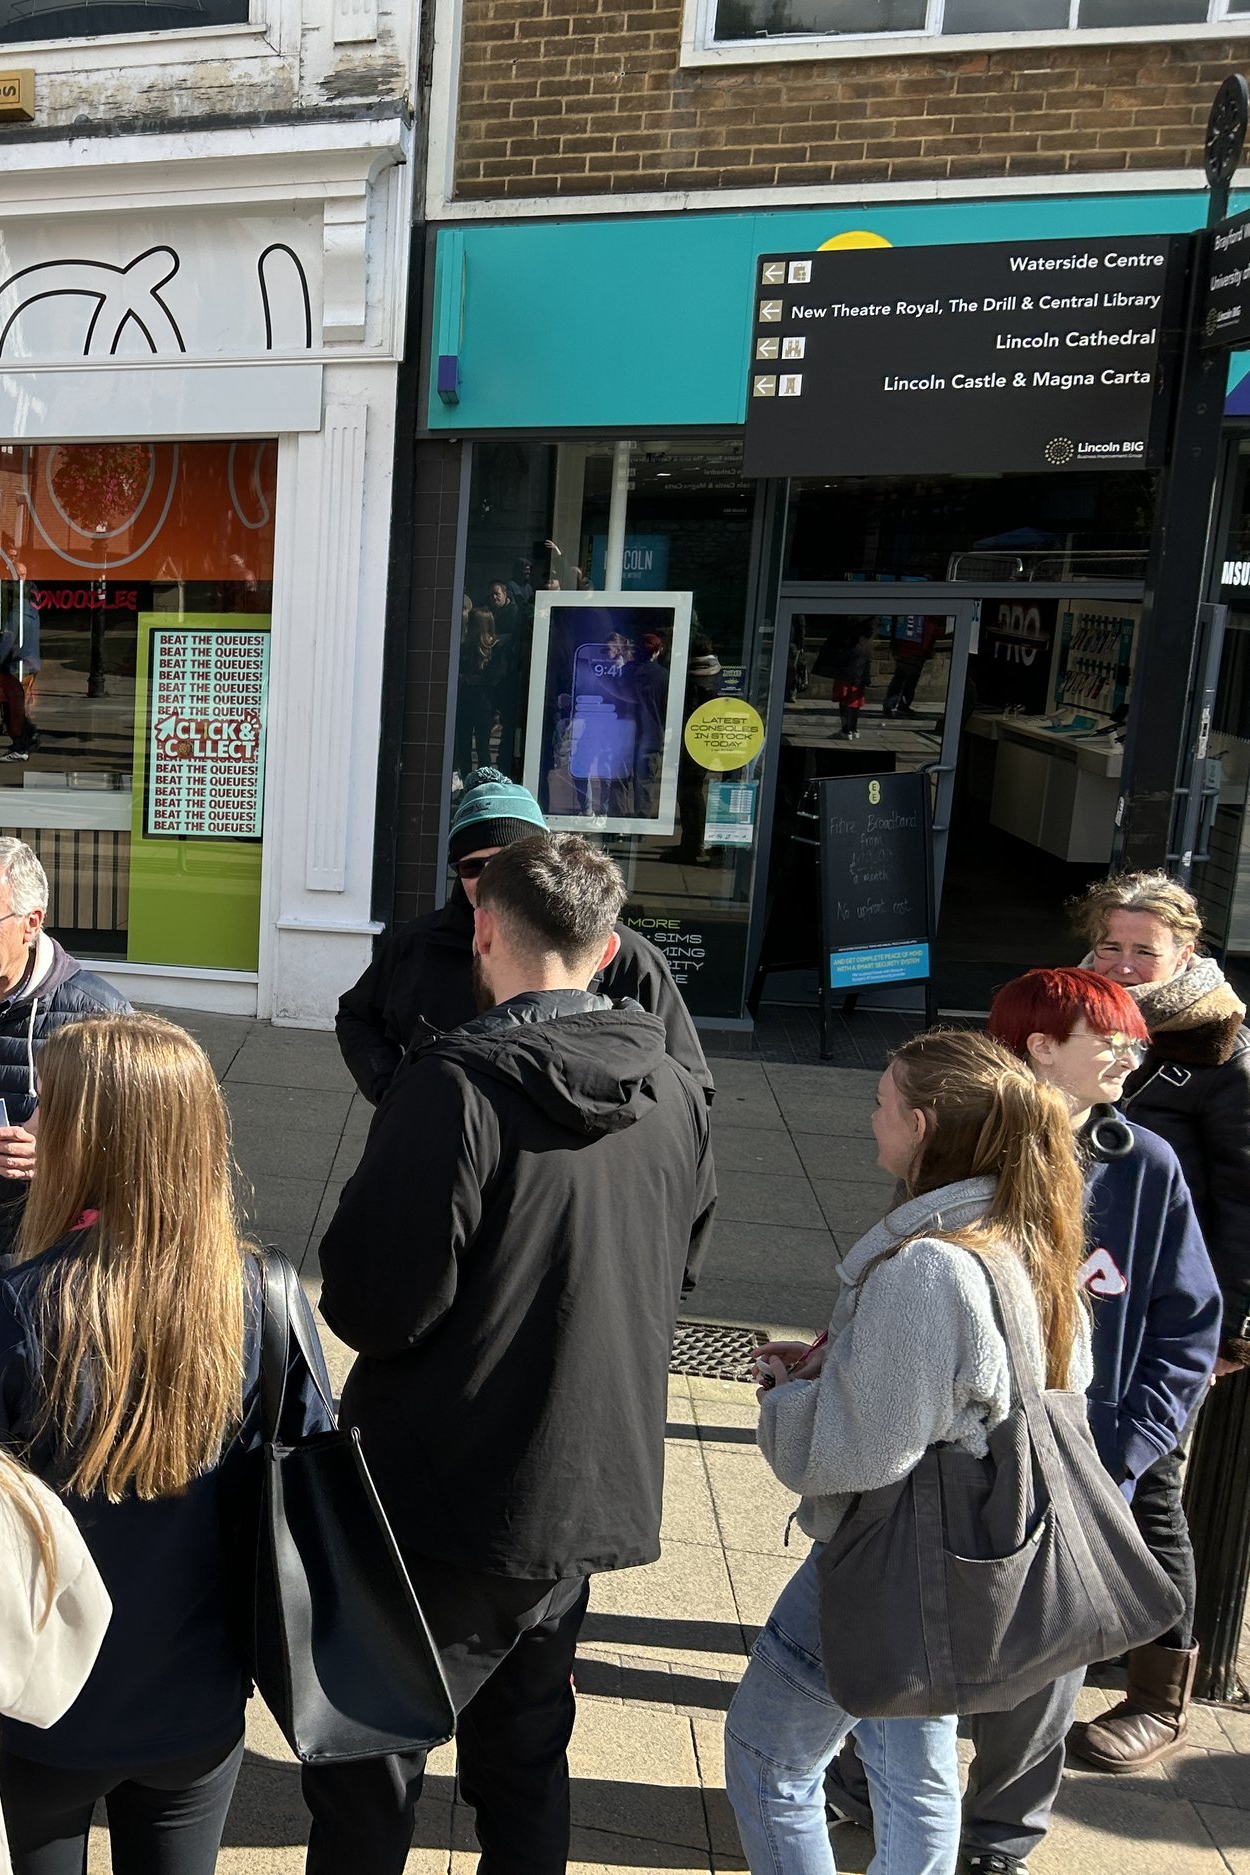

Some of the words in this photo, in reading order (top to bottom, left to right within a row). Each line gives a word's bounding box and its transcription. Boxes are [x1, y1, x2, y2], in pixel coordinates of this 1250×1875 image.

[1214, 225, 1244, 251] Brayford
[1010, 254, 1099, 272] Waterside
[1104, 253, 1164, 268] Centre
[1210, 268, 1242, 291] University
[791, 304, 827, 319] New
[832, 302, 891, 317] Theatre
[896, 299, 944, 318] Royal,
[950, 298, 978, 313] The
[983, 296, 1016, 311] Drill
[1022, 297, 1033, 310] &
[1039, 293, 1098, 309] Central
[1104, 291, 1161, 309] Library
[996, 333, 1059, 349] Lincoln
[1065, 329, 1156, 346] Cathedral
[884, 375, 945, 391] Lincoln
[951, 373, 1006, 389] Castle
[1012, 373, 1026, 388] &
[1033, 371, 1094, 390] Magna
[1101, 370, 1151, 385] Carta
[1078, 442, 1120, 452] Lincoln
[1122, 441, 1144, 452] BIG
[1221, 561, 1250, 586] MSU
[160, 635, 188, 645] BEAT
[191, 635, 212, 645] THE
[216, 636, 264, 646] QUEUES!
[160, 647, 188, 657] BEAT
[191, 648, 212, 657] THE
[215, 648, 264, 658] QUEUES!
[159, 659, 187, 668] BEAT
[190, 660, 211, 669] THE
[214, 660, 263, 670] QUEUES!
[594, 664, 622, 677] 9:41
[159, 671, 187, 680] BEAT
[190, 671, 211, 681] THE
[214, 672, 262, 682] QUEUES!
[158, 683, 186, 692] BEAT
[189, 683, 210, 693] THE
[213, 684, 262, 694] QUEUES!
[158, 695, 186, 704] BEAT
[189, 695, 210, 705] THE
[213, 696, 261, 706] QUEUES!
[188, 707, 210, 716] THE
[176, 721, 237, 739] CLICK
[238, 723, 255, 740] &
[690, 724, 759, 733] CONSOLES
[156, 764, 183, 773] BEAT
[186, 765, 207, 774] THE
[210, 765, 258, 775] QUEUES!
[155, 776, 182, 785] BEAT
[186, 776, 207, 785] THE
[210, 777, 257, 787] QUEUES!
[155, 787, 182, 796] BEAT
[185, 788, 206, 797] THE
[209, 788, 257, 798] QUEUES!
[155, 799, 182, 808] BEAT
[185, 799, 206, 808] THE
[209, 800, 256, 810] QUEUES!
[154, 810, 182, 819] BEAT
[185, 810, 205, 820] THE
[208, 811, 256, 821] QUEUES!
[154, 821, 181, 830] BEAT
[184, 822, 205, 831] THE
[208, 823, 255, 833] QUEUES!
[628, 918, 681, 929] MORE
[654, 932, 702, 944] SIMS
[661, 947, 705, 958] MING
